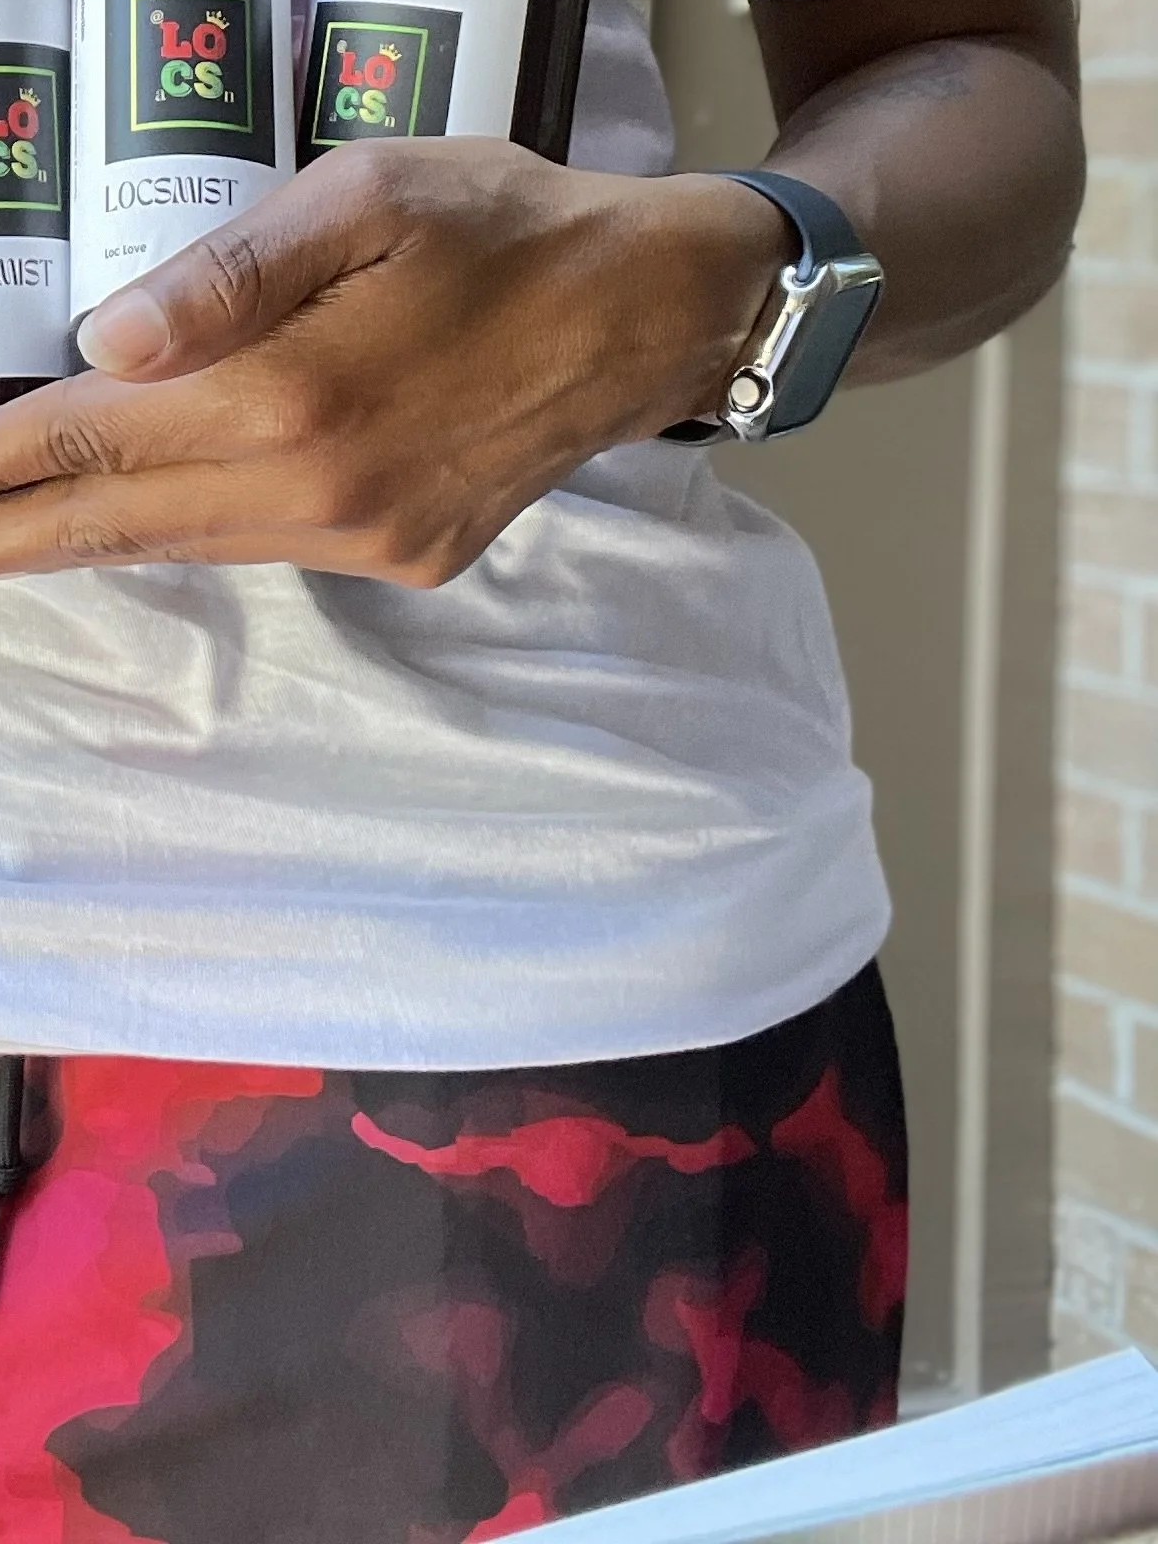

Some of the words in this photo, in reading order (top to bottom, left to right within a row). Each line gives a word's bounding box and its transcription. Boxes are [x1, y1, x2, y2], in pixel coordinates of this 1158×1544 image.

[105, 176, 240, 213] LOCSMIST
[104, 246, 121, 259] Loc
[123, 242, 147, 257] Love
